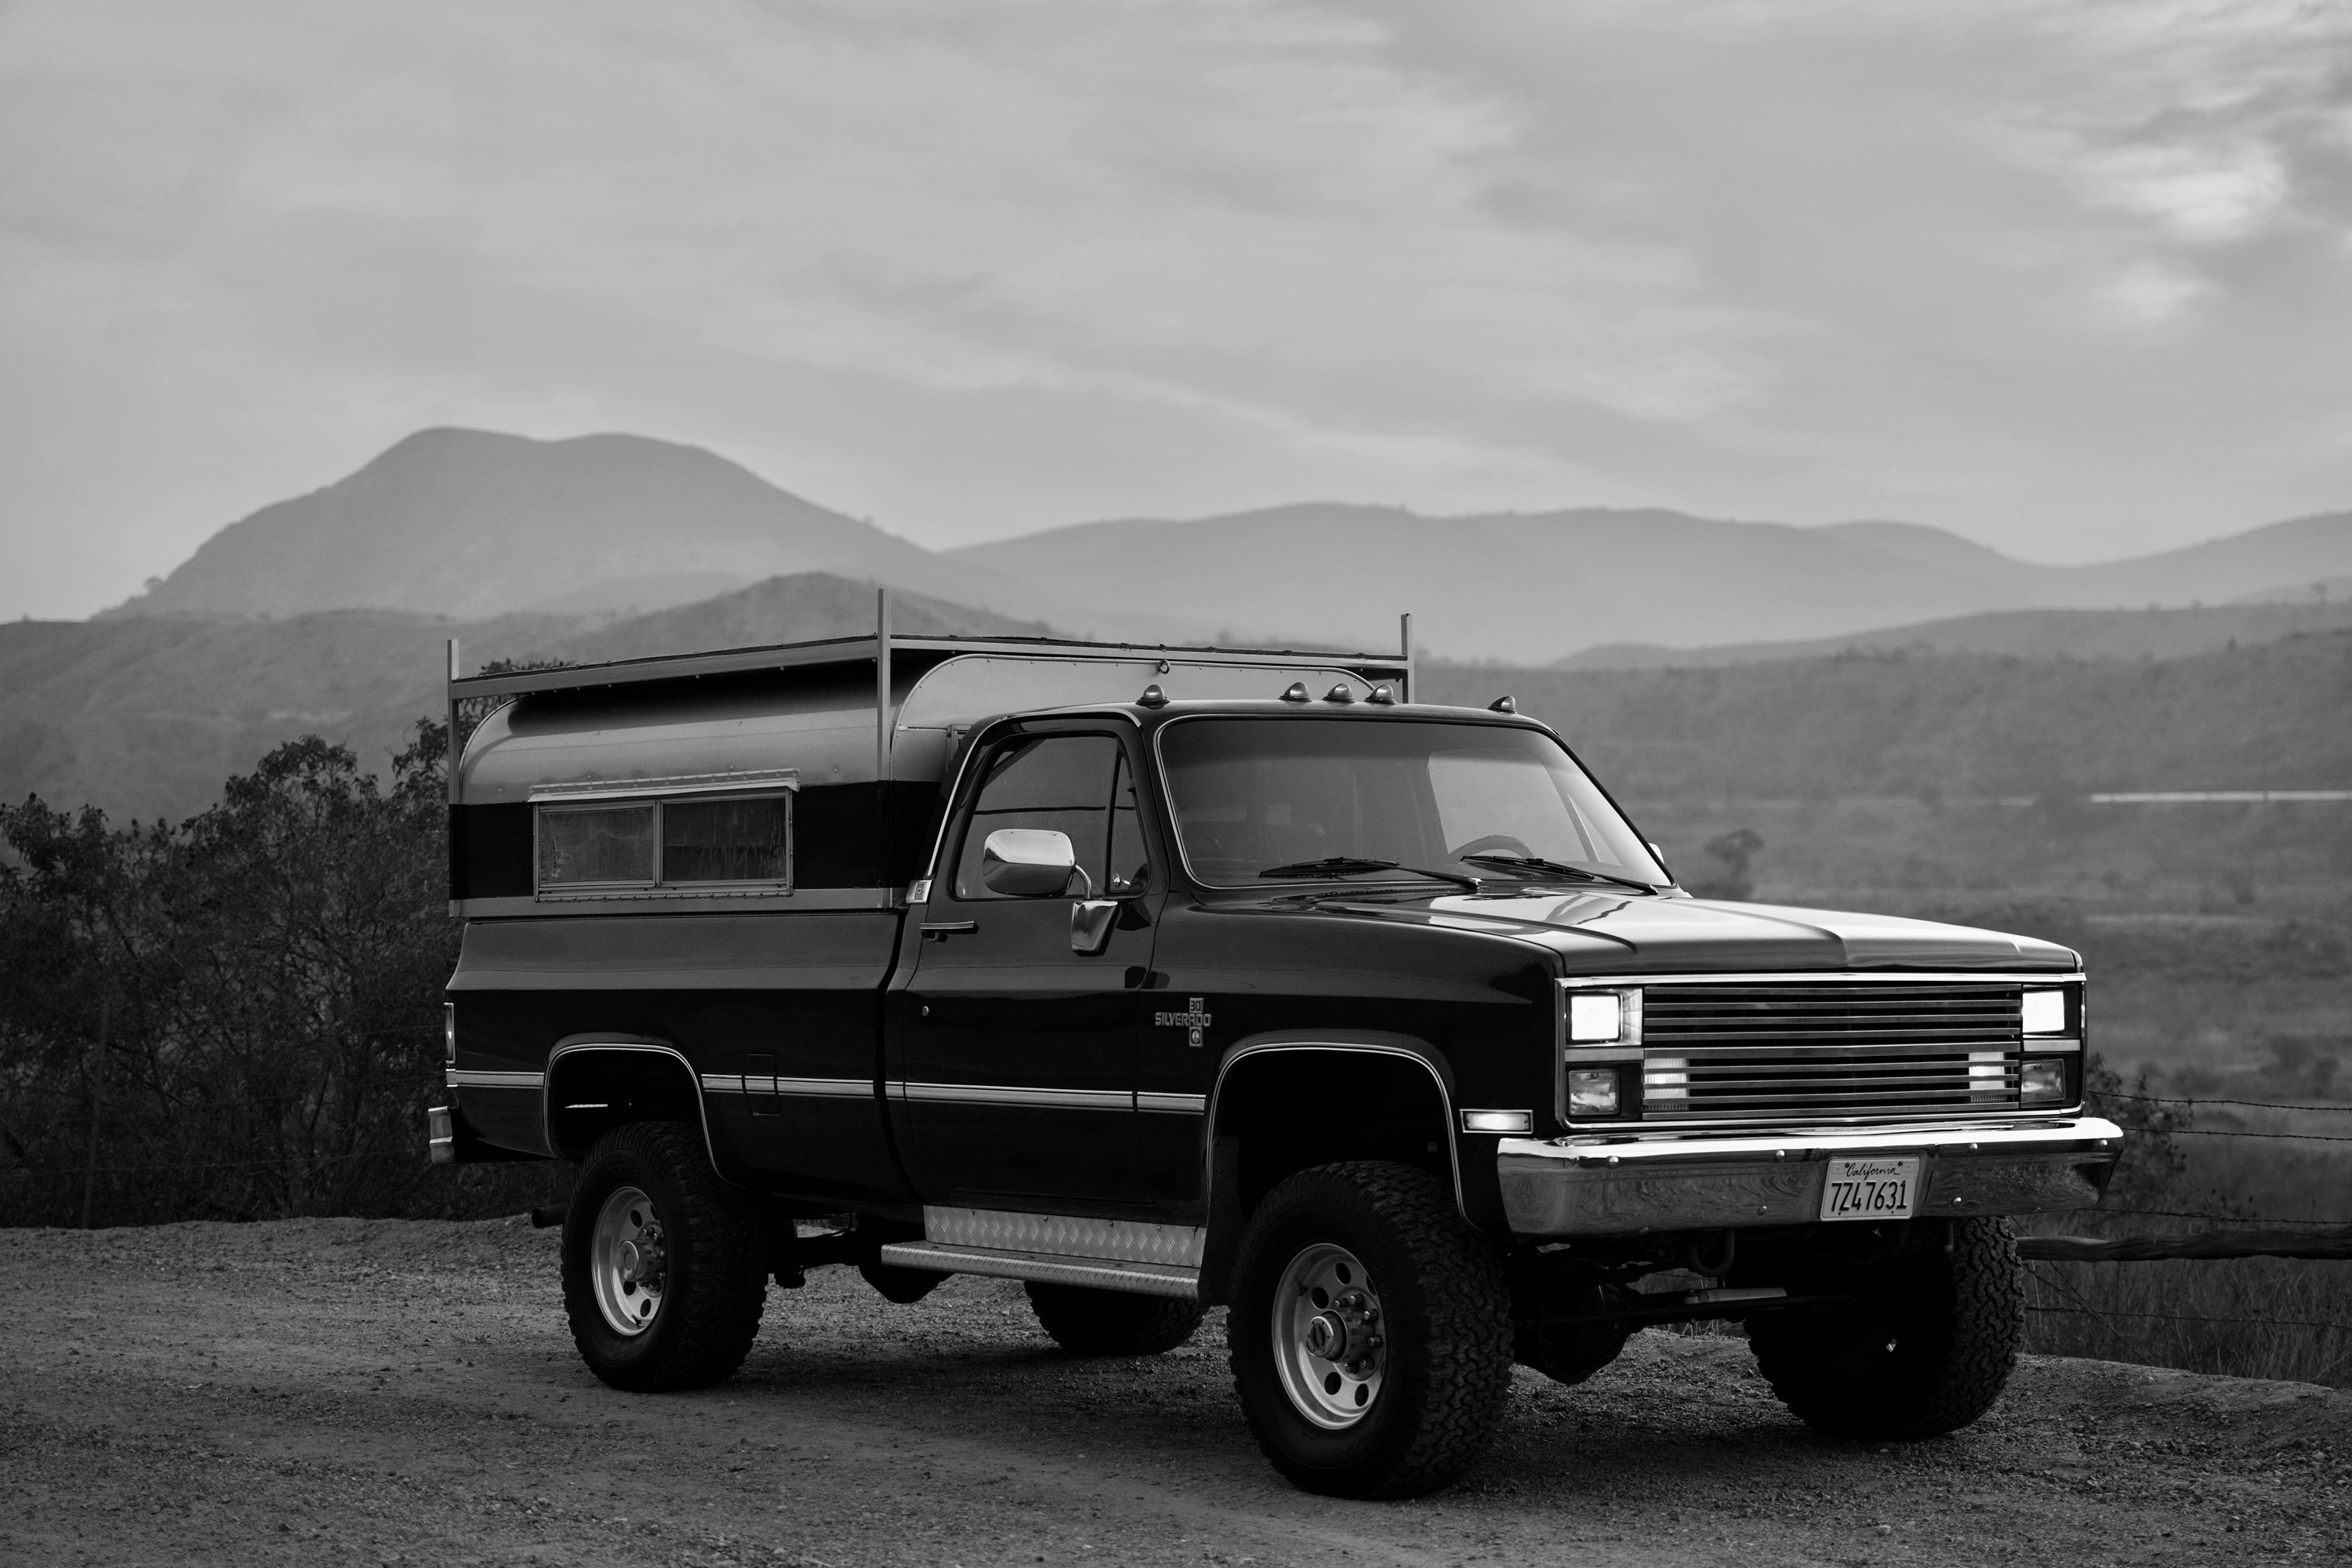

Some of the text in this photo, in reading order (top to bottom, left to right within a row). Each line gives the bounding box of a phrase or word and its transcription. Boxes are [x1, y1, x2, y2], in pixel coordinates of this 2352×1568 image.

[1189, 1000, 1202, 1012] 30
[1155, 1012, 1211, 1027] SILVERADO
[1846, 1163, 1900, 1181] California
[1831, 1181, 1907, 1211] 7Z47631
